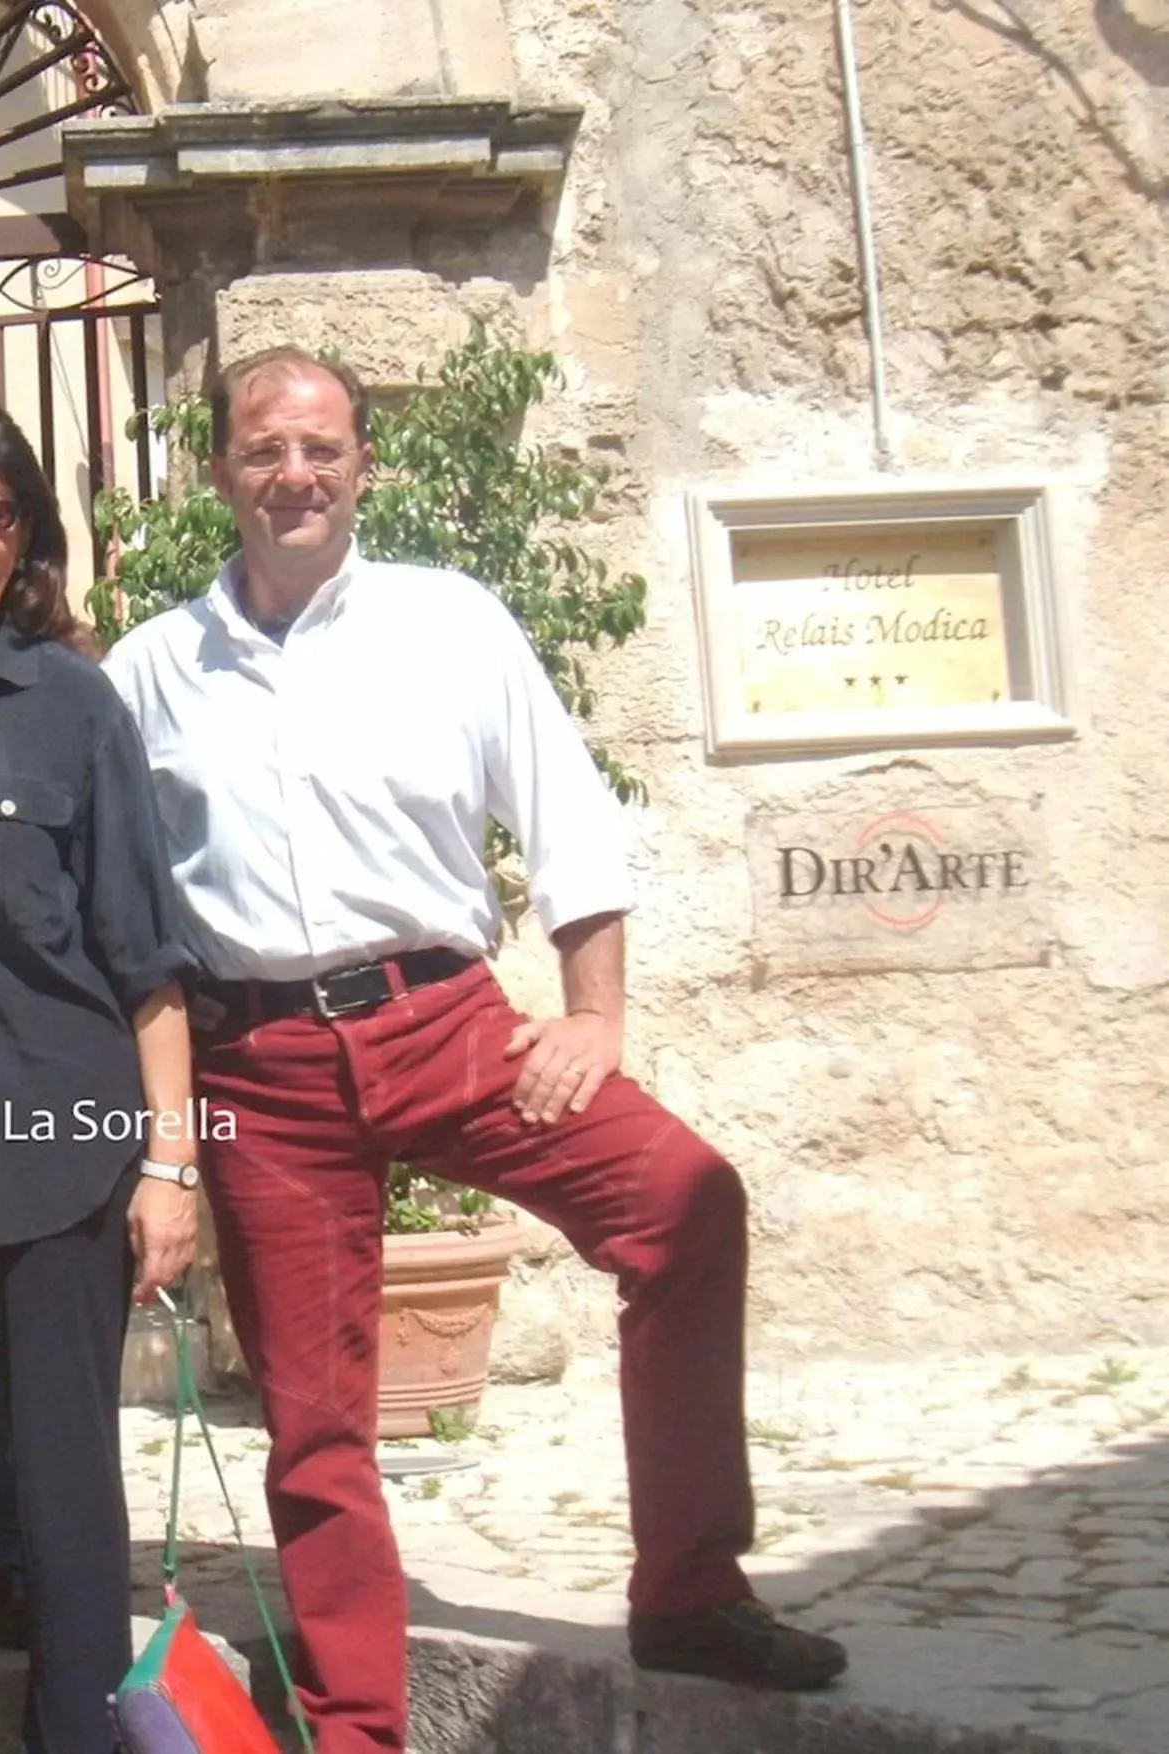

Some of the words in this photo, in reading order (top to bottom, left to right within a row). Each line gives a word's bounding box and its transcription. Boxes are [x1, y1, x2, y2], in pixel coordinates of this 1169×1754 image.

[822, 555, 919, 593] Hotel
[756, 612, 855, 655] Relais
[865, 607, 989, 648] Modica
